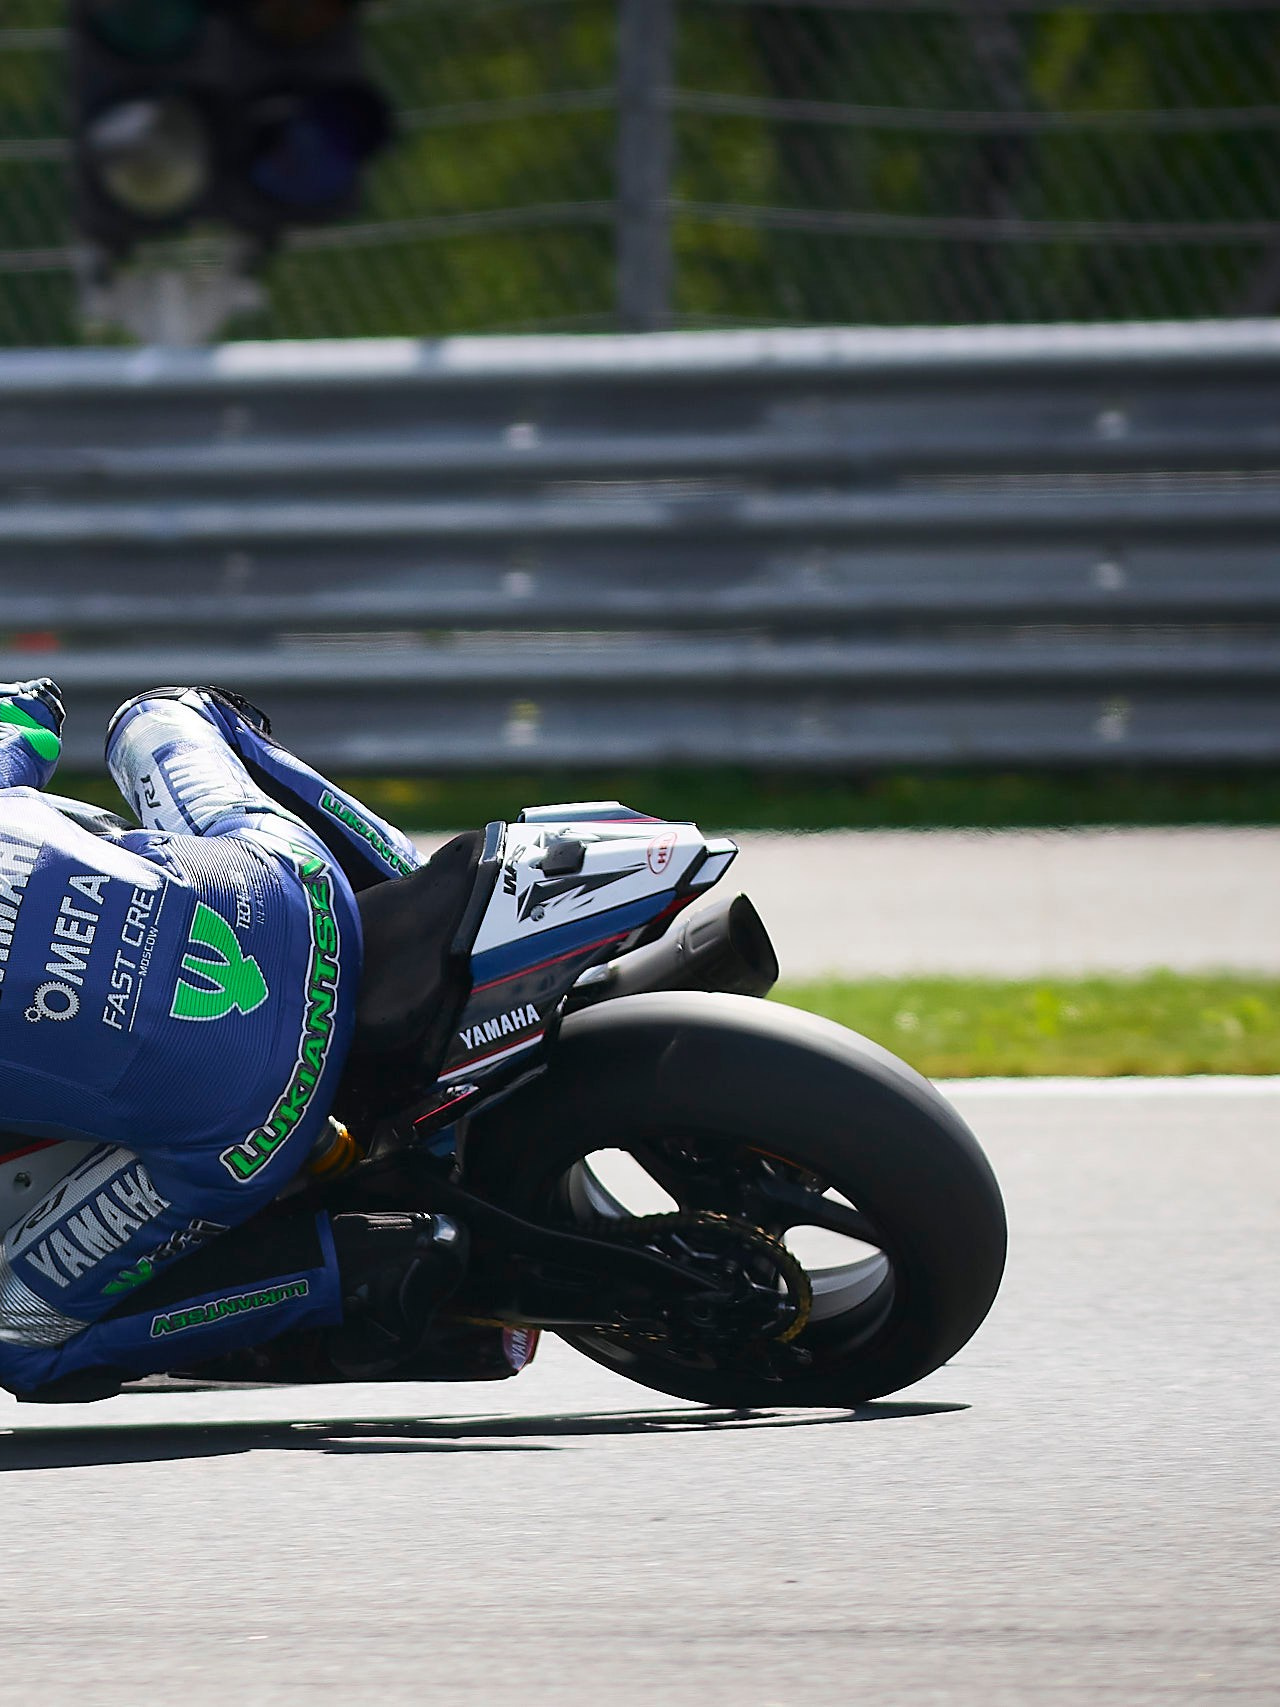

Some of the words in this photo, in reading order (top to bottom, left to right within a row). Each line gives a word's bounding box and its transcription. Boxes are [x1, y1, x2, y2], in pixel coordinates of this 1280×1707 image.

[139, 923, 160, 977] MOSCOW
[102, 949, 138, 1030] FAST
[459, 1003, 541, 1050] YAMAHA
[25, 1164, 171, 1288] YAMAHA
[150, 1279, 309, 1338] LUKIANTSEV
